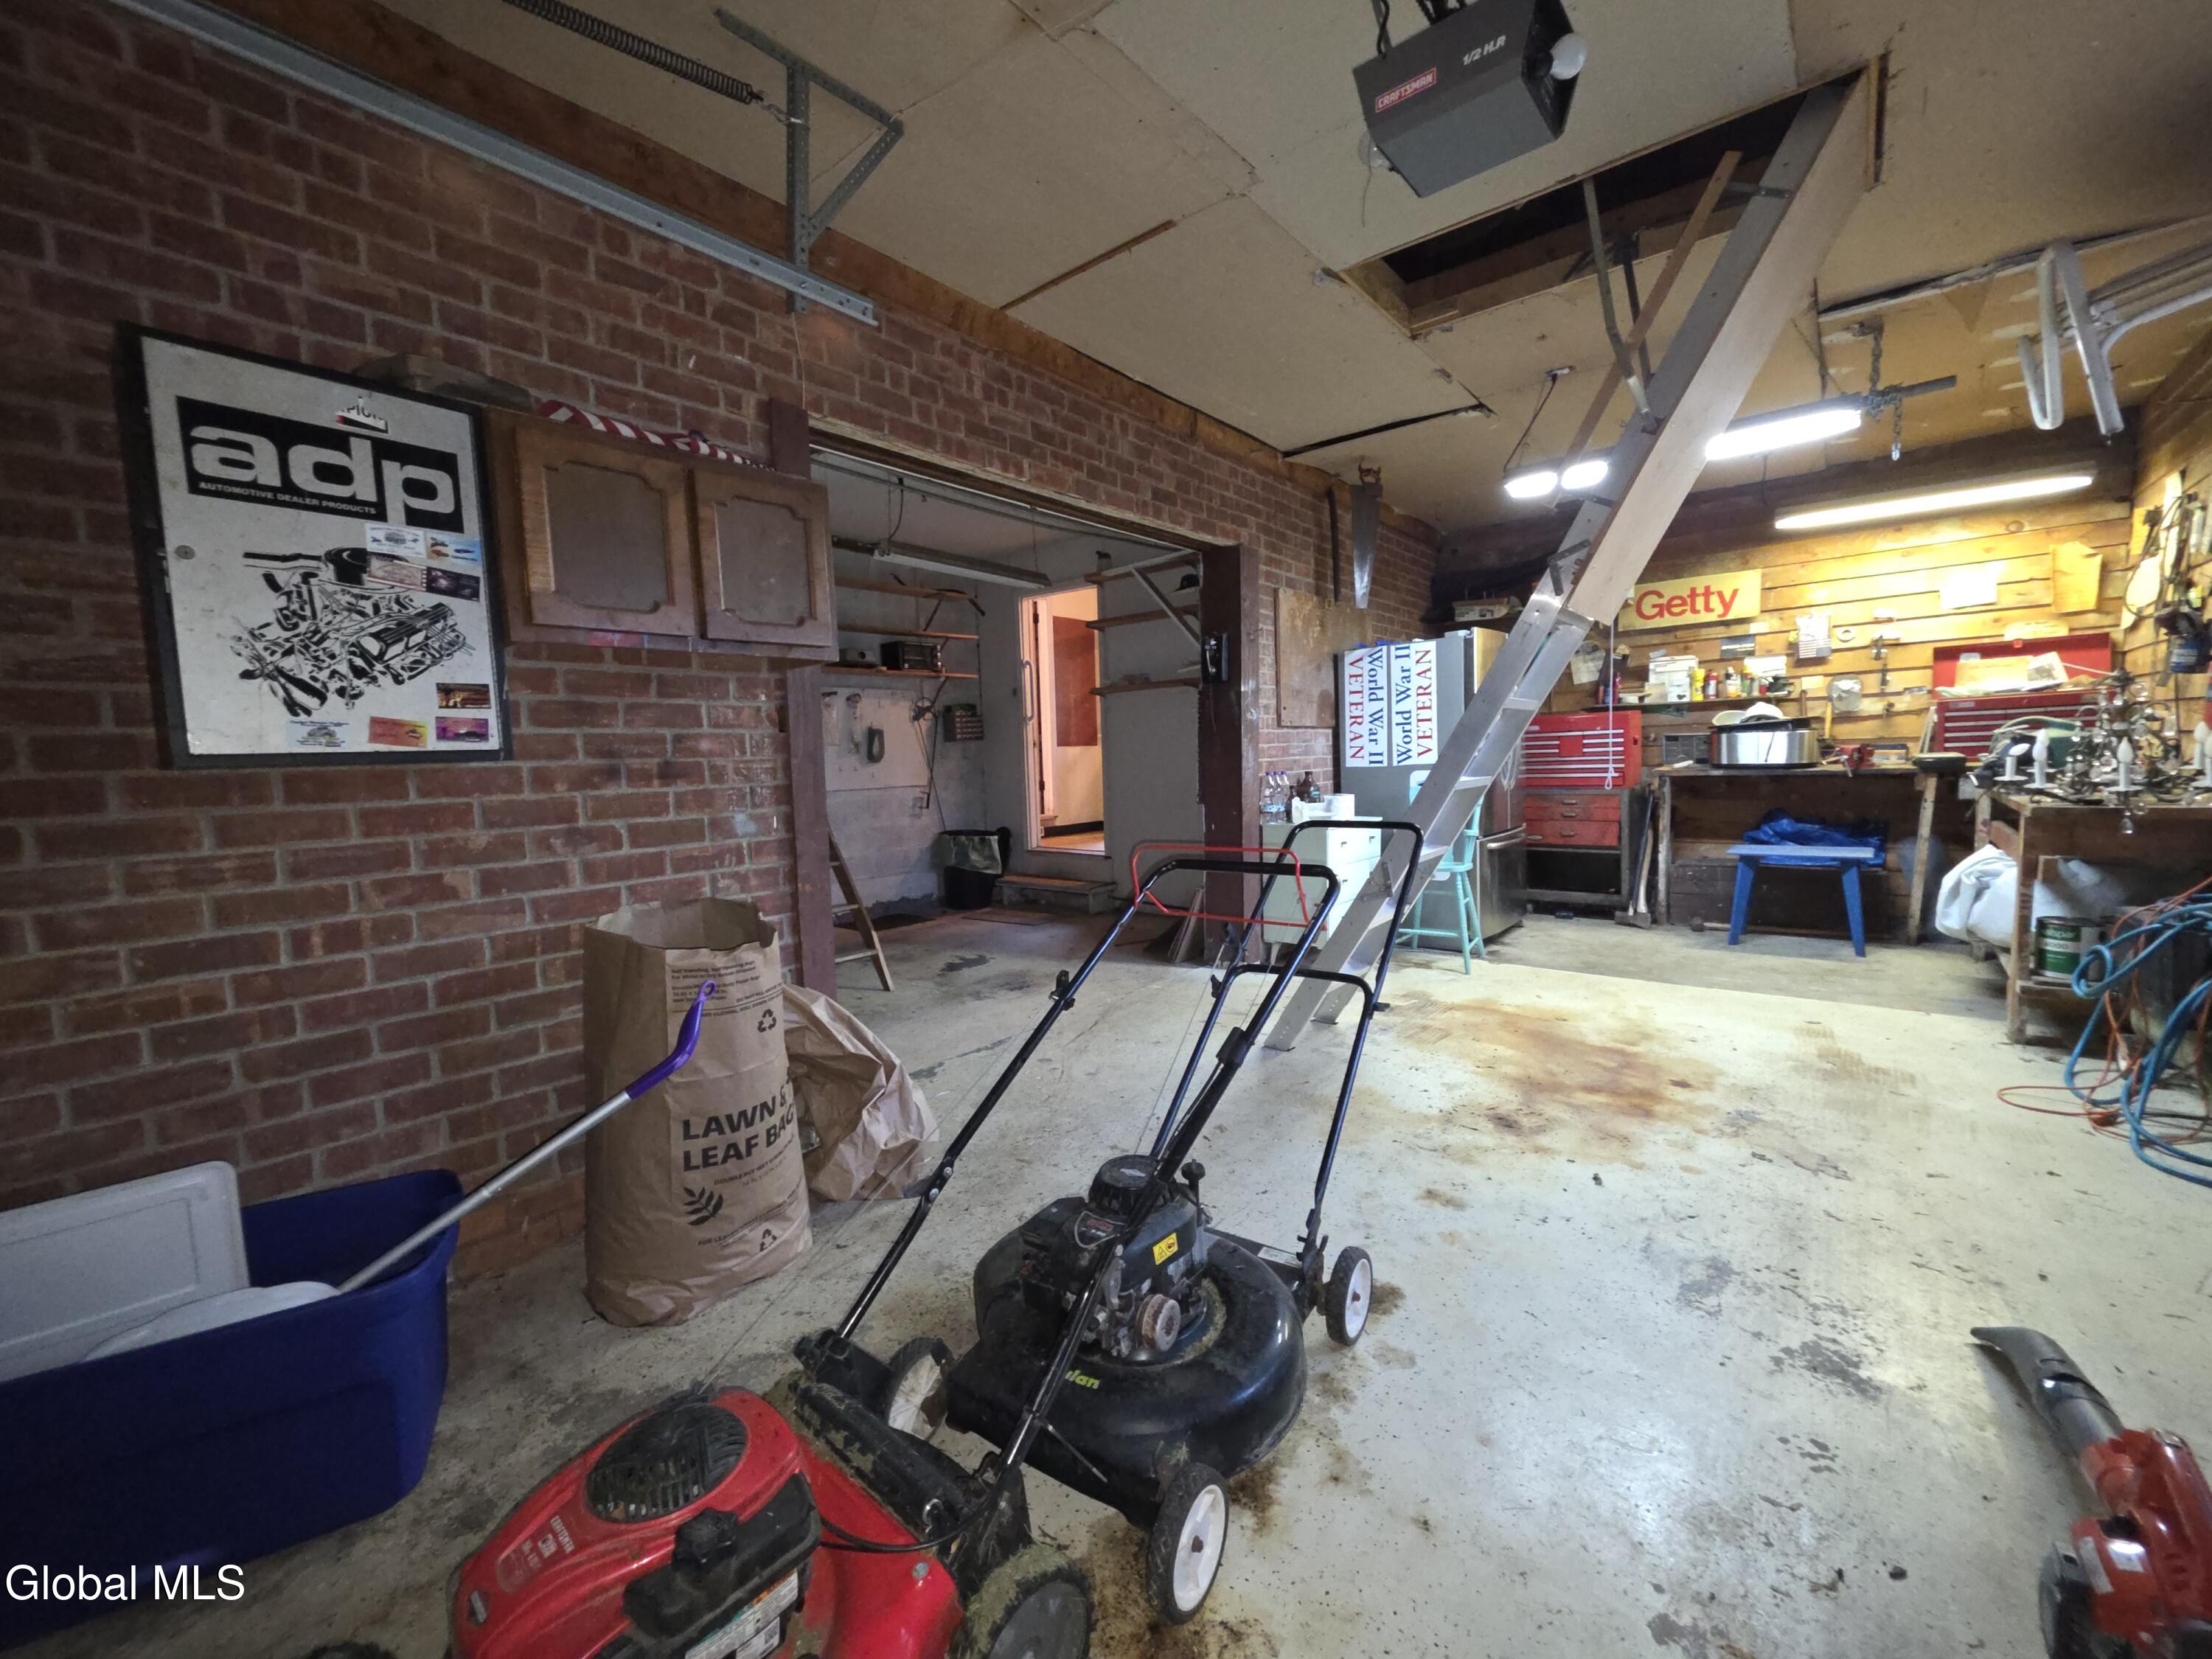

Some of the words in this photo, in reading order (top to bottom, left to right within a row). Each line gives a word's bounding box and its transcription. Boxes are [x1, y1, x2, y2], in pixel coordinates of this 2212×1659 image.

[1463, 48, 1482, 66] 1/2
[1377, 72, 1435, 109] CRAFTSMAN
[190, 425, 456, 526] adp
[199, 481, 275, 499] AUTOMOTIVE
[276, 493, 320, 507] DEALER
[321, 500, 377, 515] PRODUCTS
[1635, 585, 1739, 621] Getty
[1395, 645, 1411, 660] II
[1368, 648, 1384, 702] World
[1396, 666, 1412, 705] War
[1348, 656, 1364, 759] VETERAN
[1415, 649, 1433, 758] VETERAN
[1368, 708, 1384, 745] War
[1396, 710, 1413, 765] World
[1368, 751, 1384, 765] II
[683, 1096, 776, 1141] LAWN
[683, 1134, 759, 1172] LEAF
